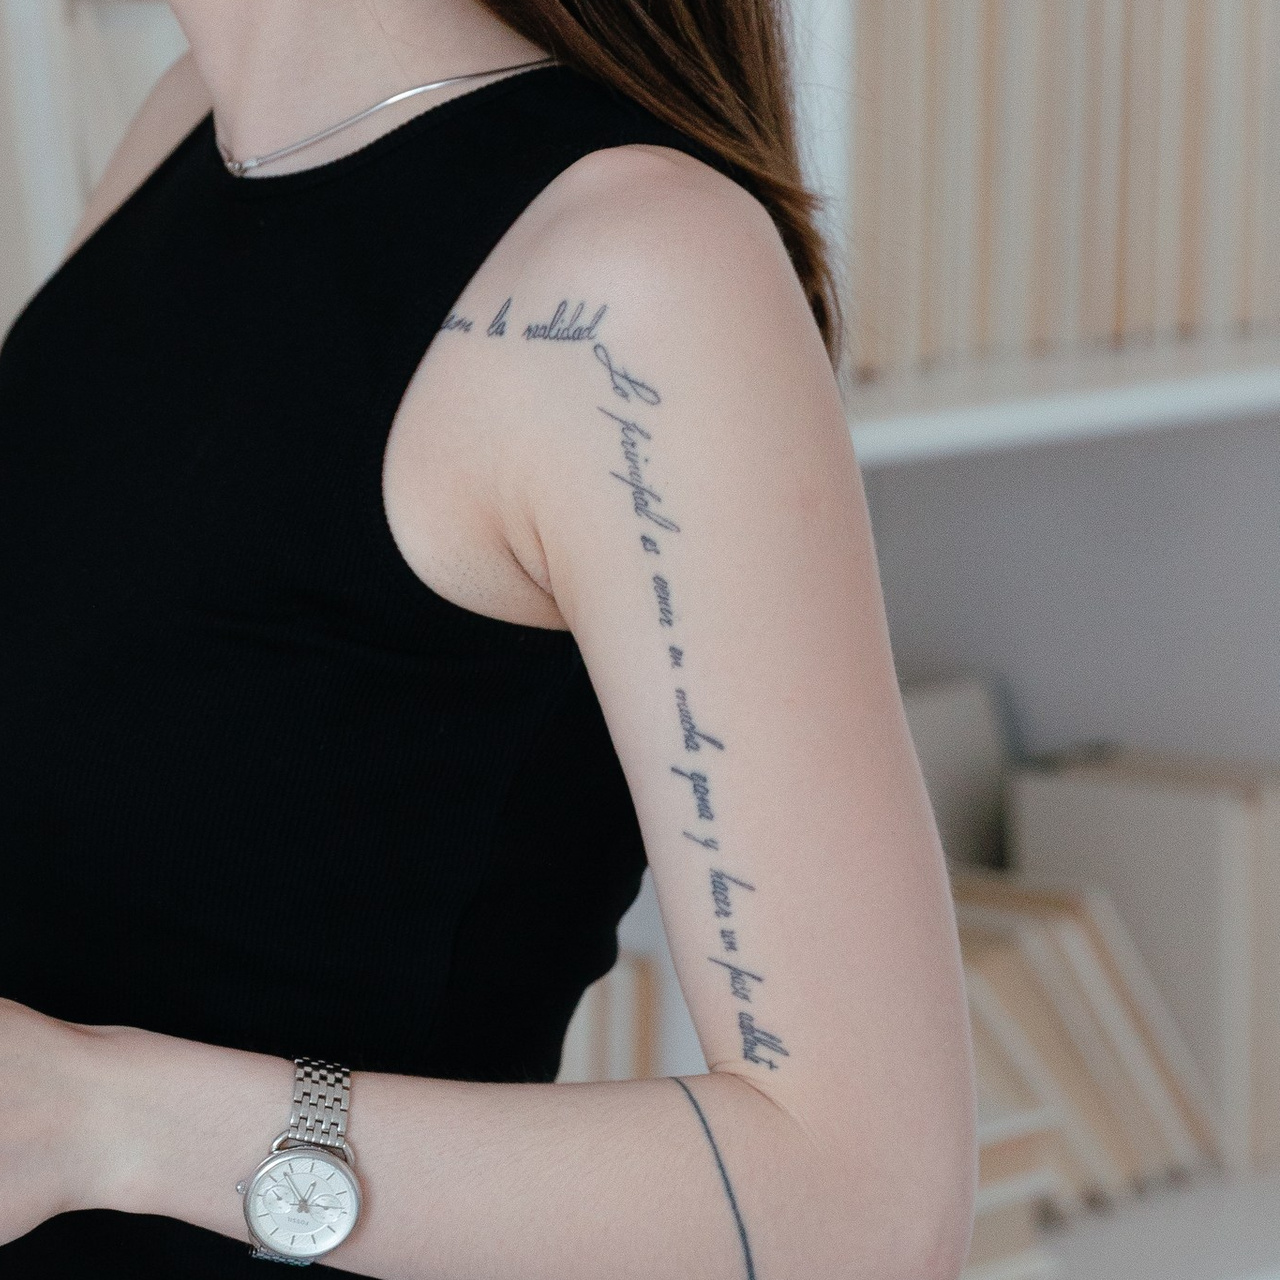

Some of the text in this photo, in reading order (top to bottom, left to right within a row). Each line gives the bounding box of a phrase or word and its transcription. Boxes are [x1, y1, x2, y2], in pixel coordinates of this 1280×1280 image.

[486, 296, 513, 338] la
[522, 299, 609, 341] realidad
[596, 405, 681, 533] principal
[640, 534, 660, 555] es
[682, 830, 719, 852] y
[709, 867, 756, 919] hacer
[720, 928, 738, 953] un
